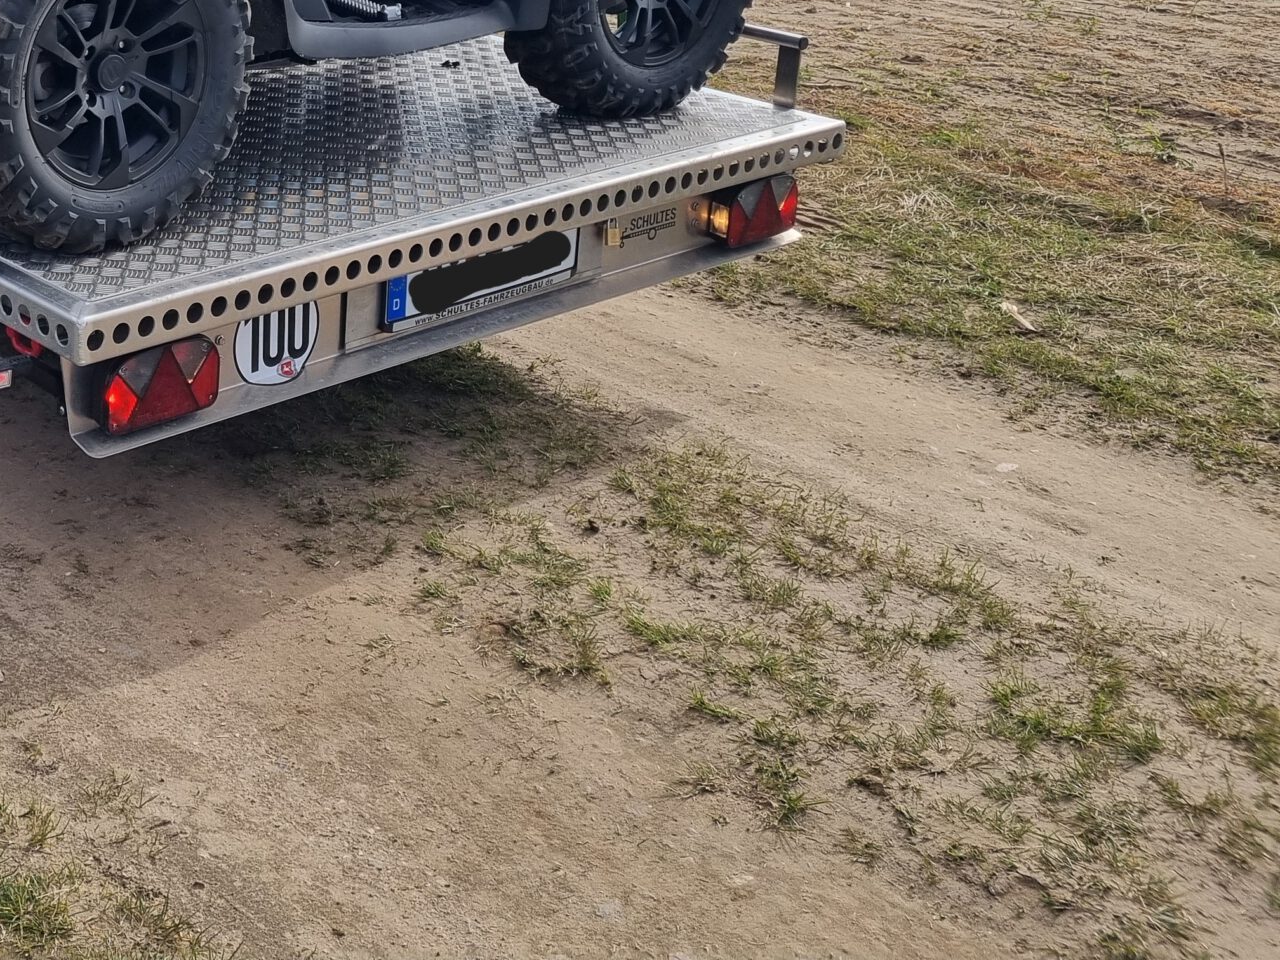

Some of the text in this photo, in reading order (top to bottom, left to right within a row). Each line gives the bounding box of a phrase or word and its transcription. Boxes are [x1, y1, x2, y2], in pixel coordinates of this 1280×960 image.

[630, 207, 677, 231] SCHULTES
[392, 297, 401, 311] D
[243, 302, 310, 373] 100
